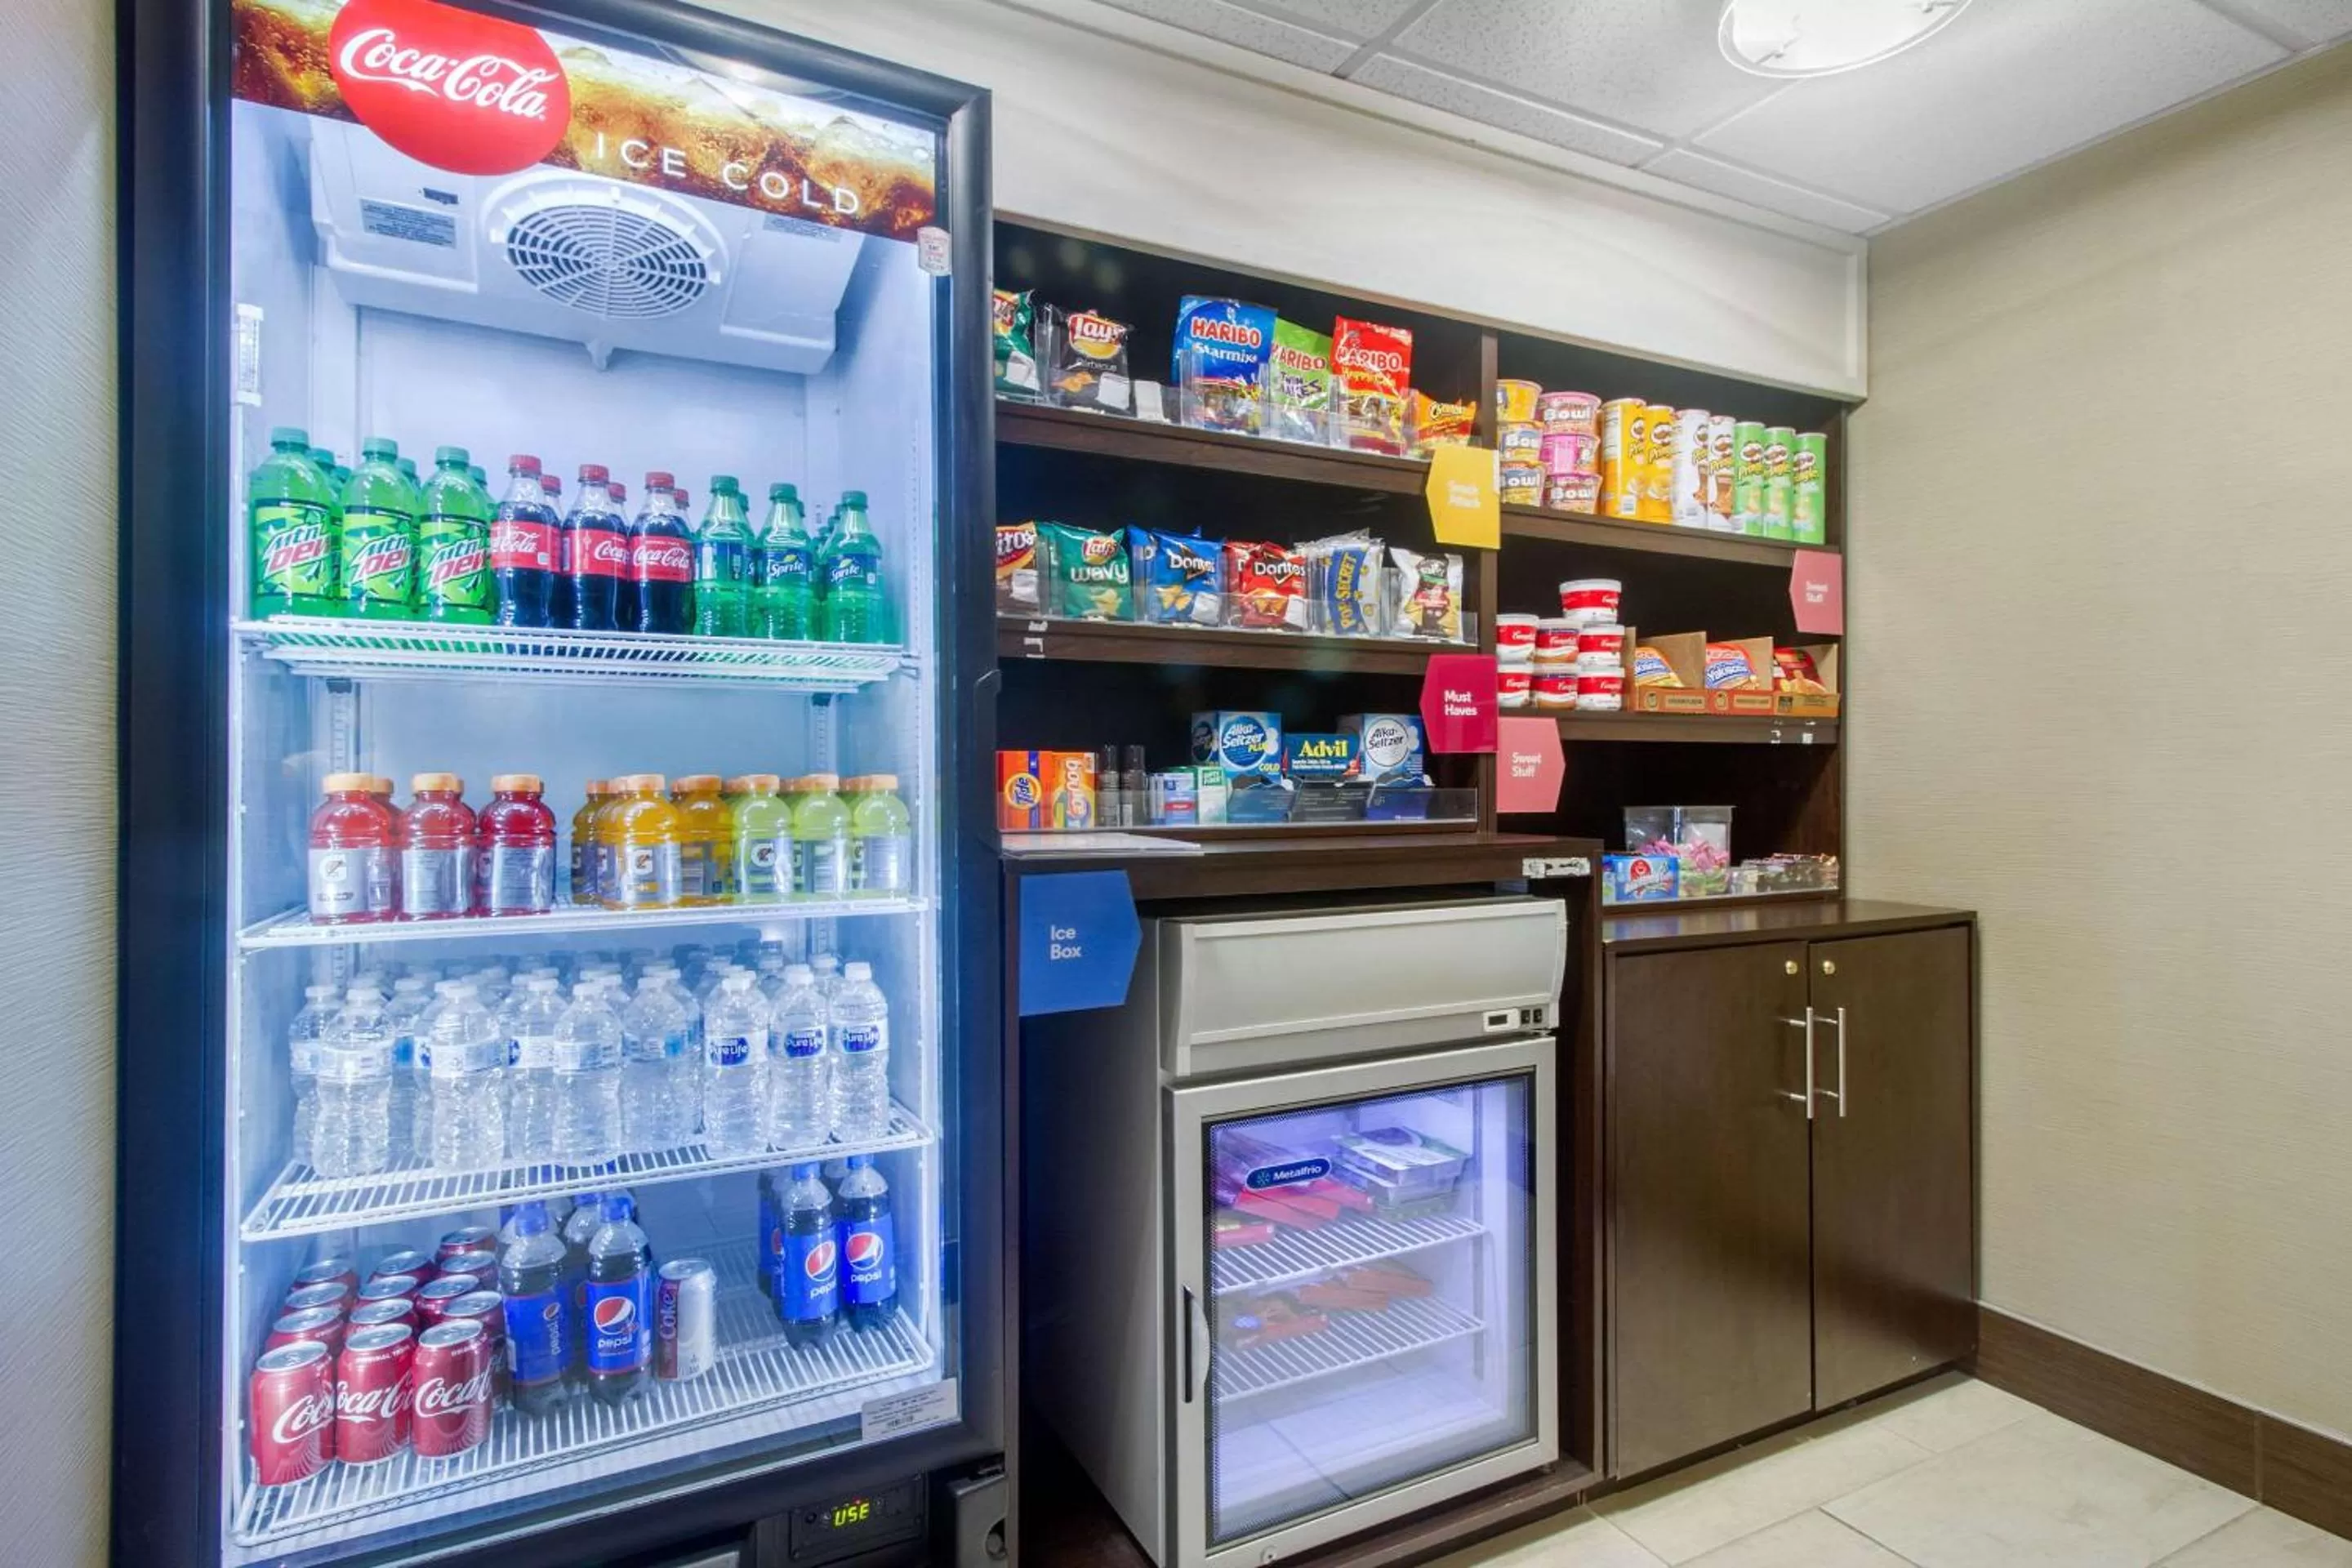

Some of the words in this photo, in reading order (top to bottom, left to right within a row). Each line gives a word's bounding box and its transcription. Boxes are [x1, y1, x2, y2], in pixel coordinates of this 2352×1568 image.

[340, 28, 560, 120] Coca-Cola
[595, 131, 688, 178] ICE
[722, 163, 862, 216] COLD
[1192, 317, 1262, 349] HARIBO
[1335, 346, 1403, 372] HARIBO
[1544, 407, 1590, 421] Bowl
[633, 545, 690, 568] Coca-Cola
[771, 562, 804, 577] Sprite
[830, 565, 860, 583] Sprite
[1444, 690, 1472, 703] Must
[1444, 704, 1478, 716] Haves
[1222, 733, 1264, 749] Seltzer
[1298, 739, 1348, 757] Advil
[1368, 735, 1405, 750] Seltzer
[1512, 751, 1542, 764] Sweet
[1512, 766, 1536, 778] Stuff
[1013, 776, 1036, 805] Tide
[1050, 924, 1076, 941] Ice
[1050, 943, 1082, 960] Box
[1273, 1165, 1322, 1180] Metalfrio
[850, 1268, 882, 1285] pepsi
[597, 1333, 633, 1349] pepsi
[833, 1503, 870, 1528] USE
